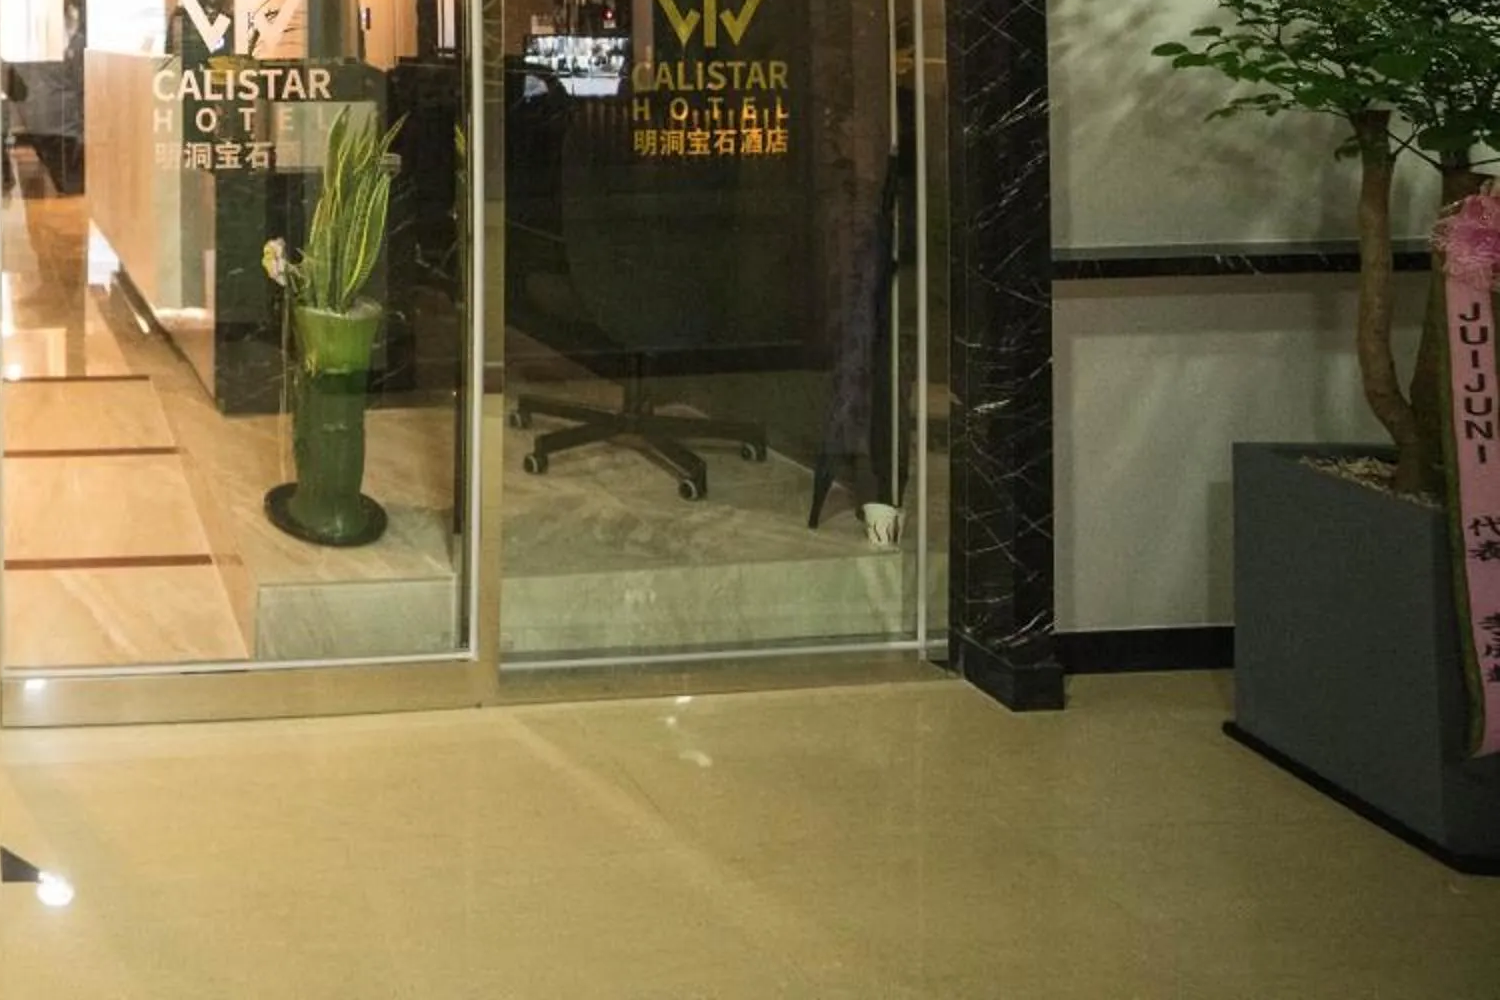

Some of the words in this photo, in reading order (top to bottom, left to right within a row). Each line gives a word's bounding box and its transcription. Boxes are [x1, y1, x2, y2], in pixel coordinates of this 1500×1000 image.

[152, 68, 332, 101] CALISTAR
[632, 60, 789, 92] CALISTAR
[633, 96, 789, 121] HOTEL
[155, 142, 329, 169] 明洞宝石
[634, 127, 789, 156] 明洞宝石酒店
